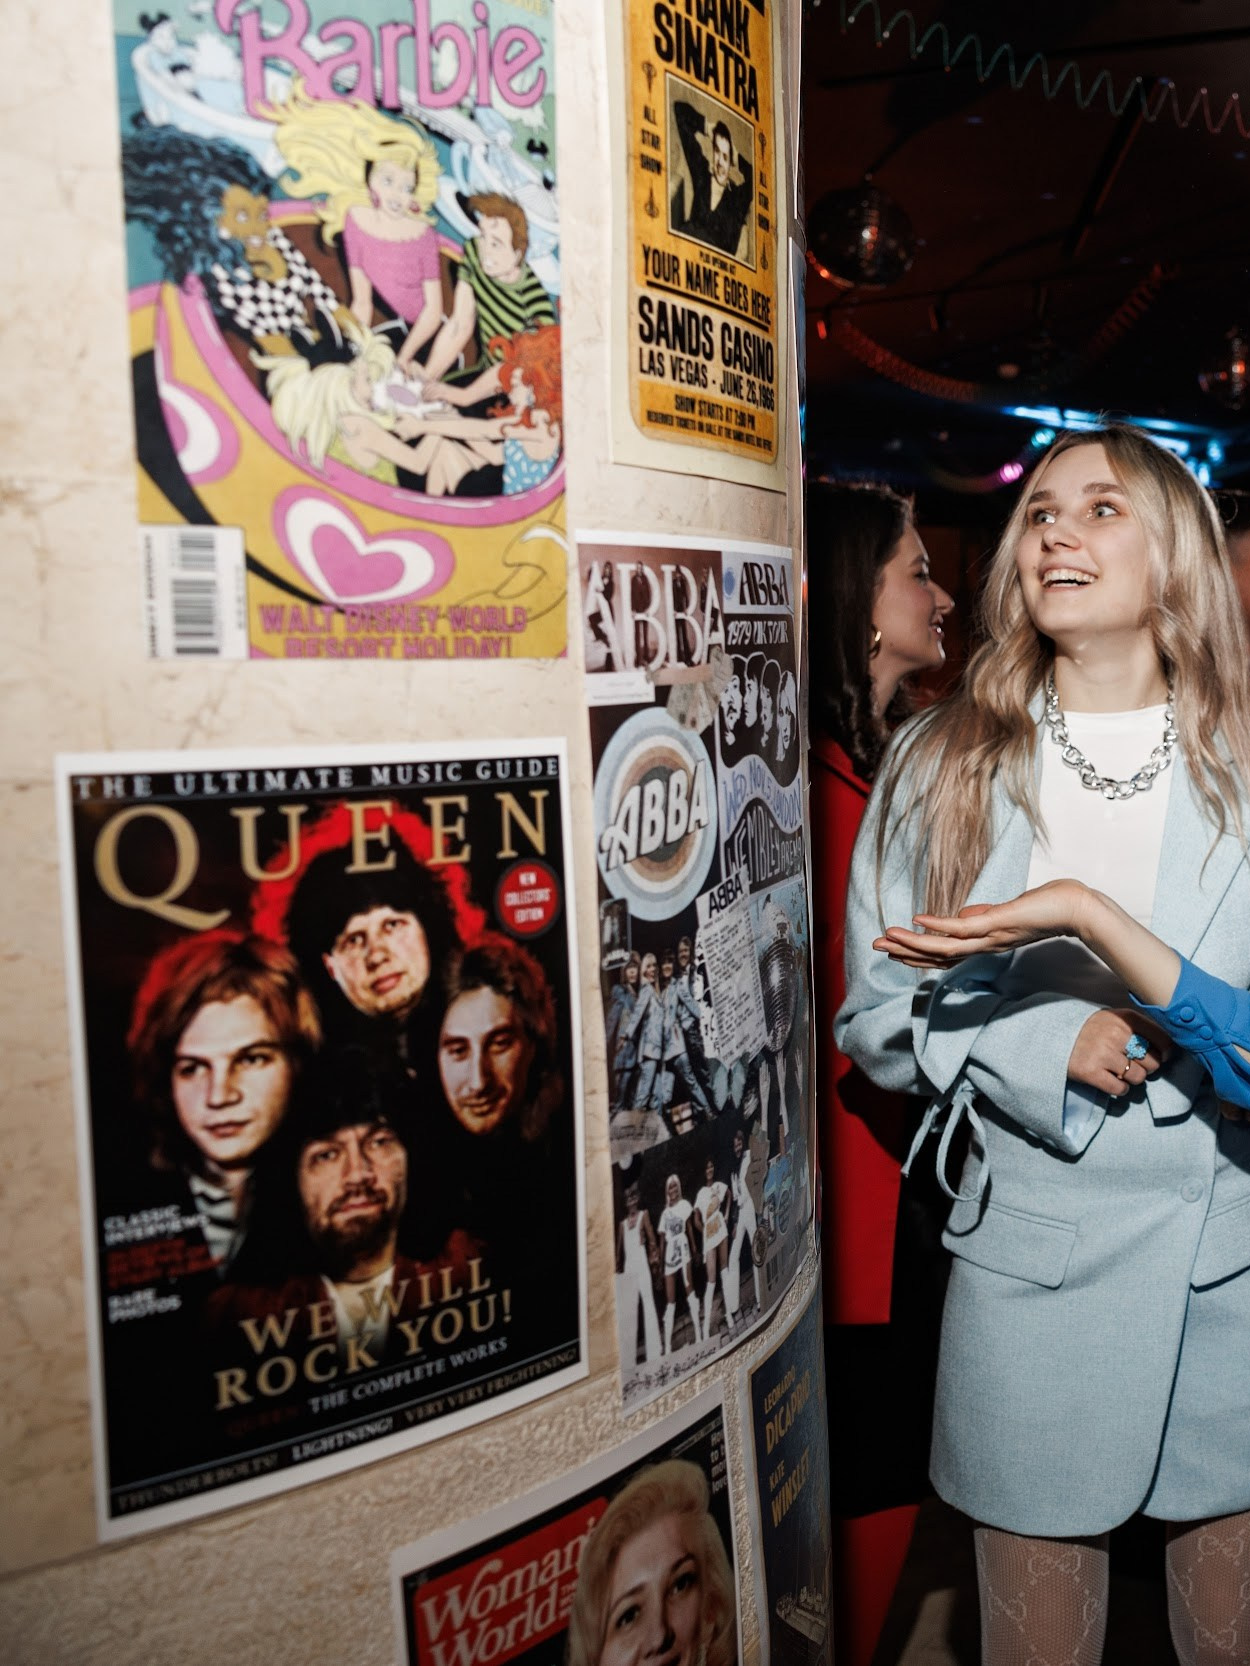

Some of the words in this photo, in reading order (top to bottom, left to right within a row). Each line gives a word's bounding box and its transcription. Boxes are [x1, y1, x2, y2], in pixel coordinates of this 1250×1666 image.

[213, 0, 547, 123] Barbie
[654, 2, 760, 122] SINATRA
[669, 0, 750, 59] ANK
[642, 244, 681, 286] YOUR
[685, 259, 720, 301] NAME
[724, 276, 748, 313] GOES
[751, 288, 771, 325] HERE
[638, 295, 714, 361] SANDS
[721, 322, 774, 384] CASINO
[639, 347, 665, 378] LAS
[670, 355, 708, 389] VEGAS
[720, 371, 744, 401] JUNE
[259, 605, 335, 633] WALT
[345, 605, 439, 633] DISNEY
[448, 605, 528, 633] WORLD
[582, 560, 725, 672] ABBA
[739, 562, 789, 605] ABBA
[727, 620, 752, 646] 1979
[753, 621, 767, 645] UK
[767, 620, 789, 644] TOUR
[76, 775, 153, 800] THE
[174, 767, 353, 797] ULTIMATE
[370, 762, 463, 787] MUSIC
[475, 757, 559, 781] GUIDE
[599, 758, 710, 872] ABBA
[94, 789, 550, 931] QUEEN
[708, 872, 744, 919] ABBA
[238, 1299, 338, 1355] WE
[360, 1257, 491, 1319] WILL
[214, 1333, 379, 1410] ROCK
[396, 1288, 513, 1356] YOU!
[308, 1387, 349, 1415] THE
[351, 1358, 447, 1402] COMPLETE
[449, 1336, 509, 1369] WORKS
